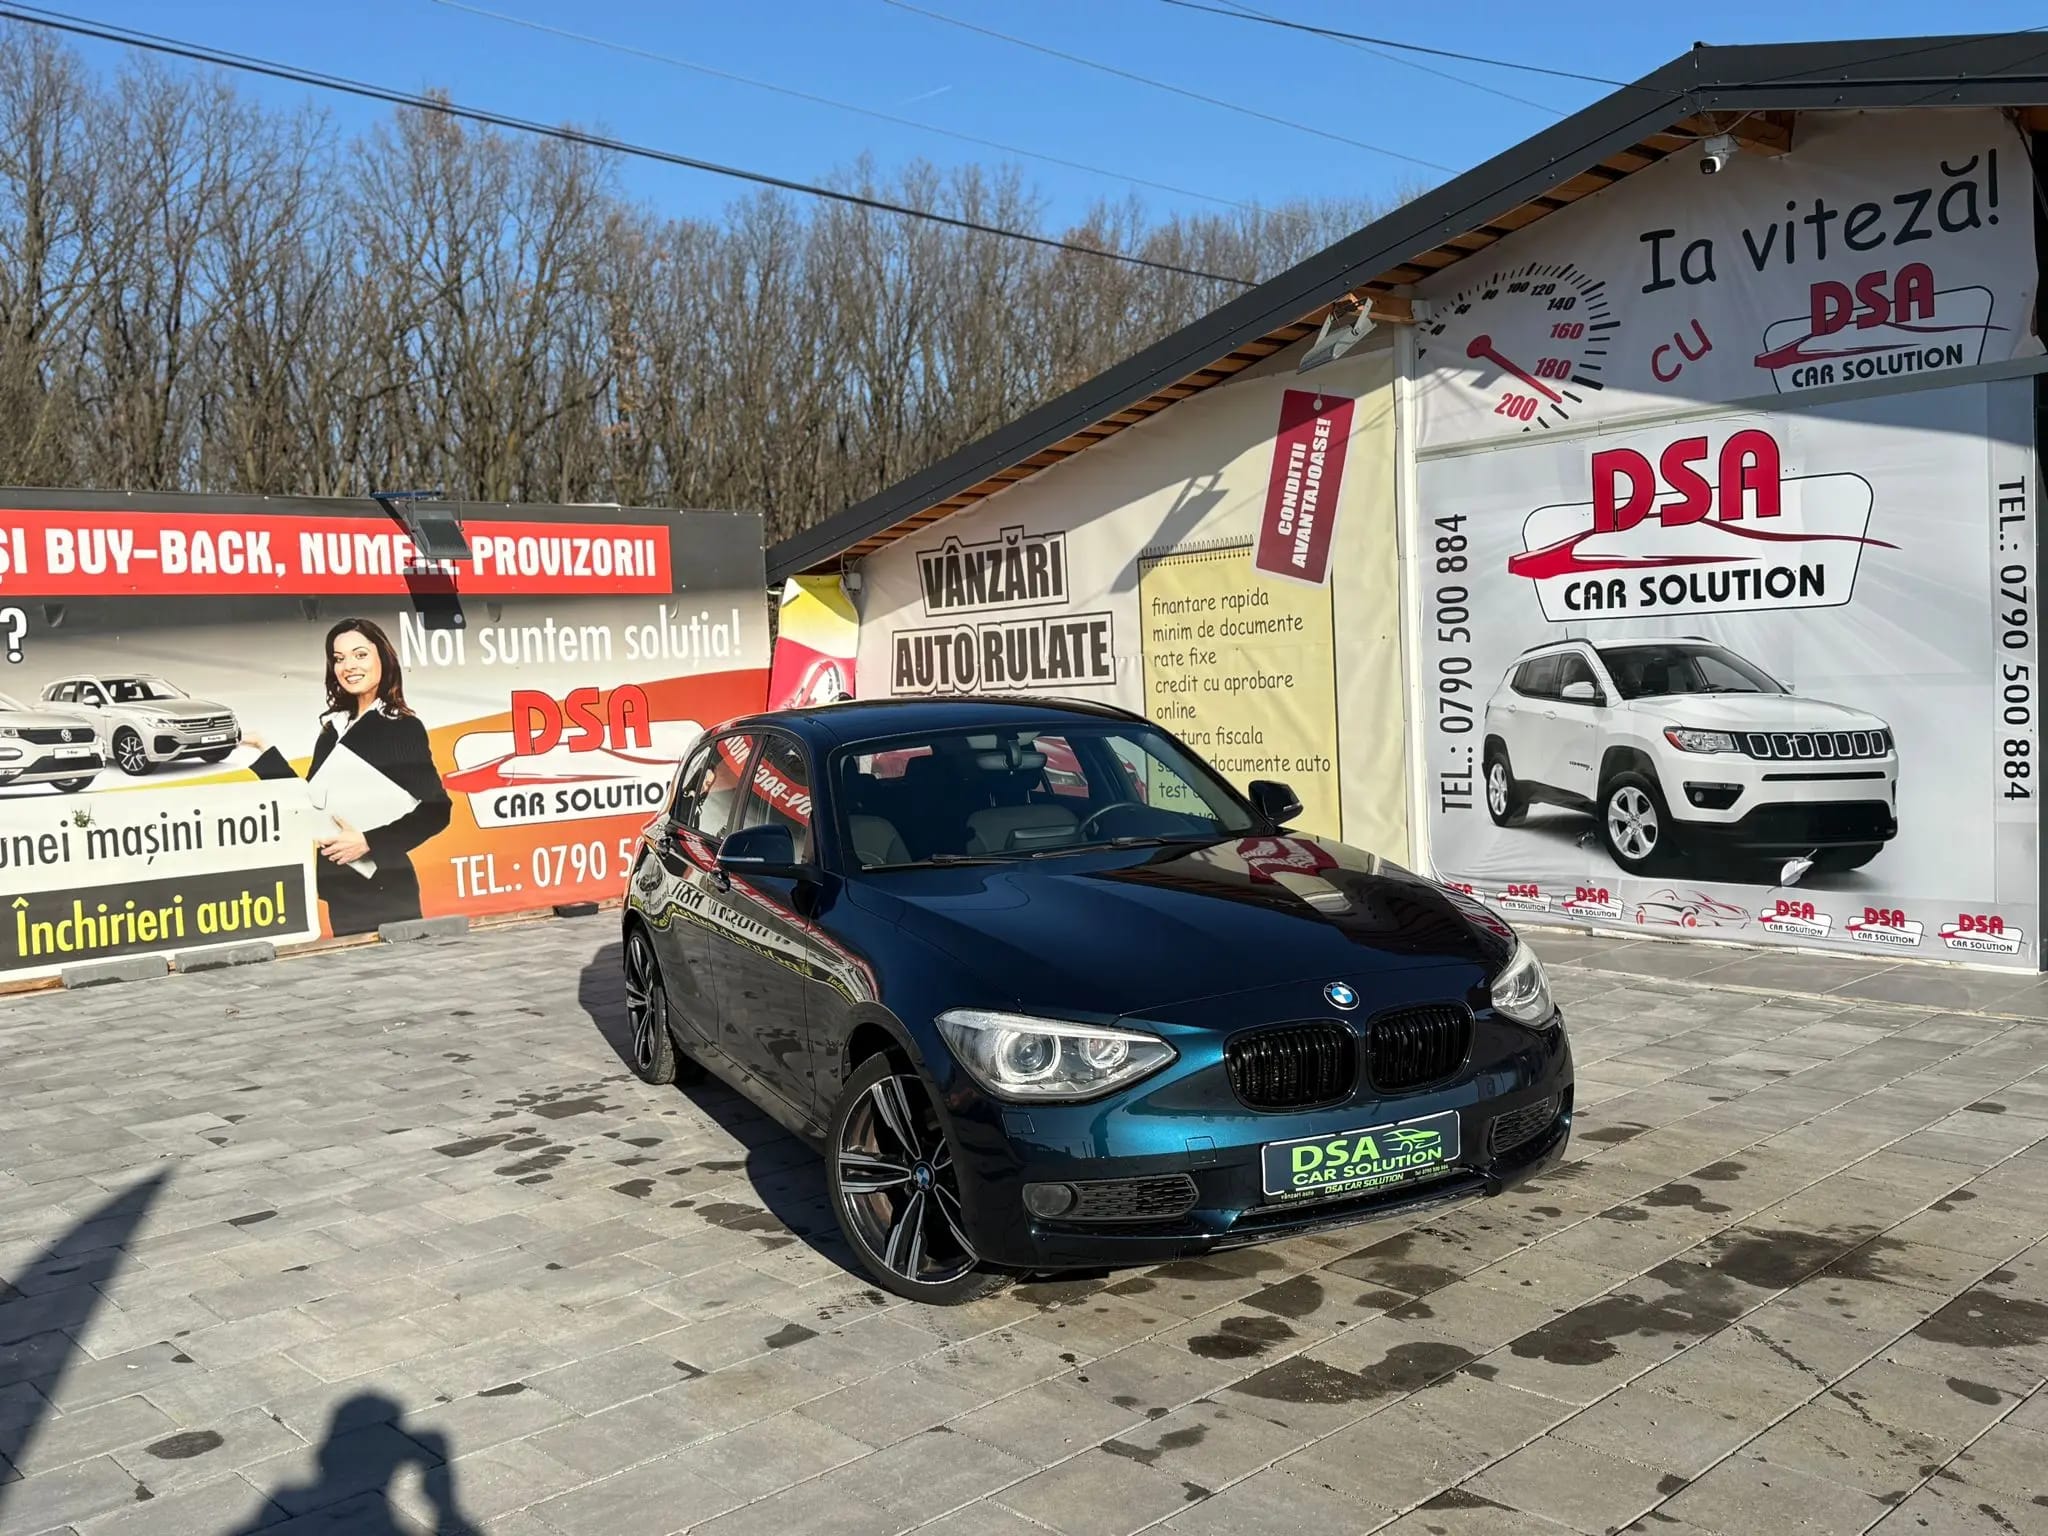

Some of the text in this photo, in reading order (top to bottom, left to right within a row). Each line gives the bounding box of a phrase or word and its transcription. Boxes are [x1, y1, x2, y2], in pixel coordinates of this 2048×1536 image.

[1639, 148, 2000, 293] Ia viteză!
[1506, 281, 1530, 293] 100
[1530, 283, 1556, 296] 120
[1810, 262, 1935, 336] DSA
[1547, 297, 1577, 311] 140
[1550, 322, 1585, 340] 160
[1651, 318, 1712, 382] cu
[1534, 357, 1572, 380] 180
[1791, 344, 1964, 388] CAR SOLUTION
[1494, 393, 1539, 421] 200
[1278, 442, 1307, 536] CONDITII
[1291, 417, 1332, 569] AVANTAJOASE!
[1592, 428, 1781, 534] DSA
[45, 528, 287, 577] BUY-BACK,
[471, 535, 657, 577] PROVIZORII
[922, 535, 1065, 609] VÂNZĂRI
[1152, 587, 1269, 617] finantare rapida
[1564, 564, 1826, 611] CAR SOLUTION
[399, 603, 743, 669] Noi suntem soluția!
[1153, 614, 1304, 642] minim de documente
[1998, 475, 2031, 800] TEL.: 0790 500 884
[896, 620, 1110, 687] AUTO RULATE
[1154, 647, 1217, 667] rate fixe
[1434, 513, 1474, 813] TEL.: 0790 500 884
[1155, 670, 1294, 696] credit cu aprobare
[511, 684, 652, 757] DSA
[1156, 701, 1197, 720] online
[1216, 726, 1264, 746] fiscala
[1296, 757, 1331, 772] auto
[494, 781, 671, 819] CAR SOLUTIO
[1159, 781, 1187, 799] test
[86, 809, 202, 865] mașini
[217, 800, 281, 847] noi!
[450, 852, 522, 899] TEL.:
[532, 840, 607, 889] 0790
[1507, 885, 1539, 898] DSA
[1575, 886, 1609, 904] DSA
[12, 881, 287, 957] Închirieri auto!
[1775, 899, 1815, 920] DSA
[1863, 907, 1905, 928] DSA
[1958, 913, 2004, 934] DSA
[1785, 925, 1824, 936] SOLUTION
[1875, 933, 1915, 944] SOLUTION
[1969, 941, 2013, 952] SOLUTION
[1292, 1135, 1380, 1173] DSA
[1292, 1167, 1337, 1185] CAR
[1343, 1147, 1442, 1178] SOLUTION
[1345, 1182, 1362, 1191] CAR
[1363, 1173, 1404, 1188] SOLUTION
